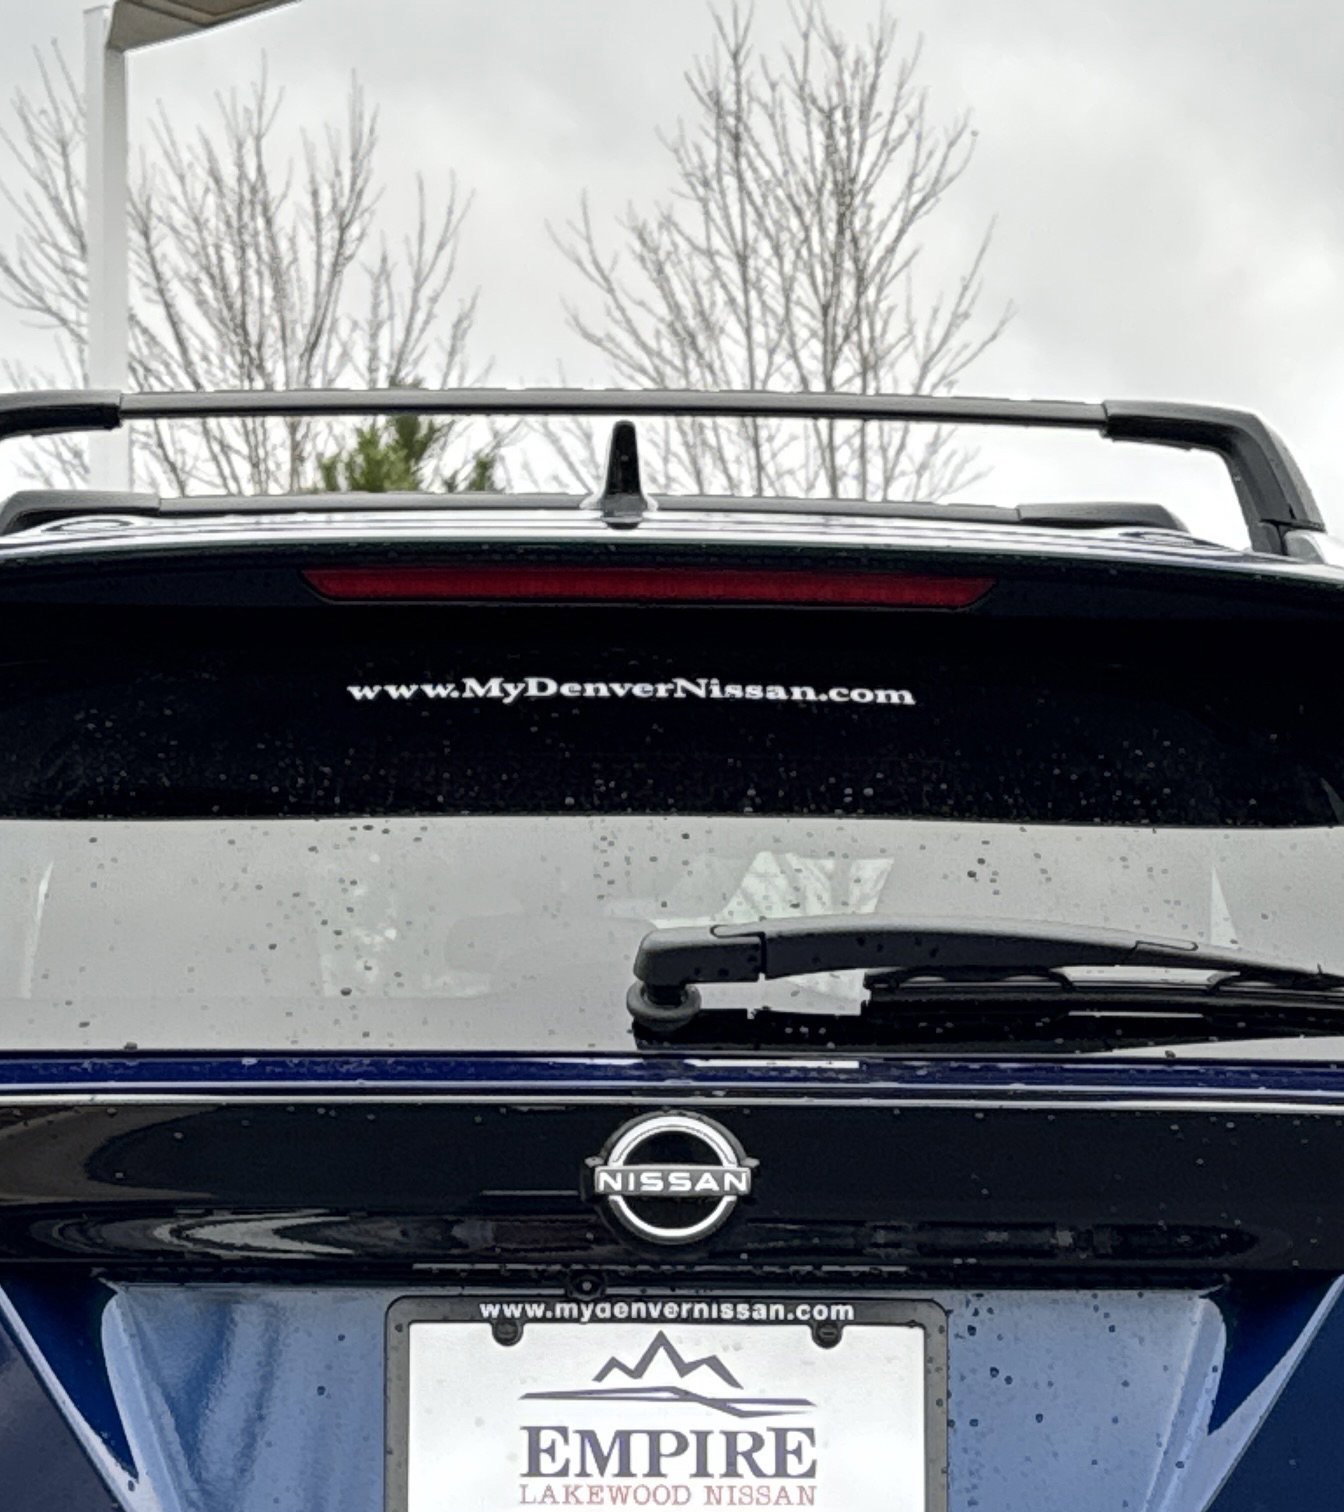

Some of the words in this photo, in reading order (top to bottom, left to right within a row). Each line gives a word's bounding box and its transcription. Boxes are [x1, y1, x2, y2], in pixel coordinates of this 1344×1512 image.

[346, 676, 917, 706] www.MyDenverNissan.com
[598, 1172, 747, 1192] NISSAN
[479, 1301, 855, 1322] www.mydenvernissan.com
[519, 1426, 817, 1479] EMPIRE
[519, 1484, 692, 1506] LAKEWOOD
[704, 1485, 817, 1507] NISSAN
